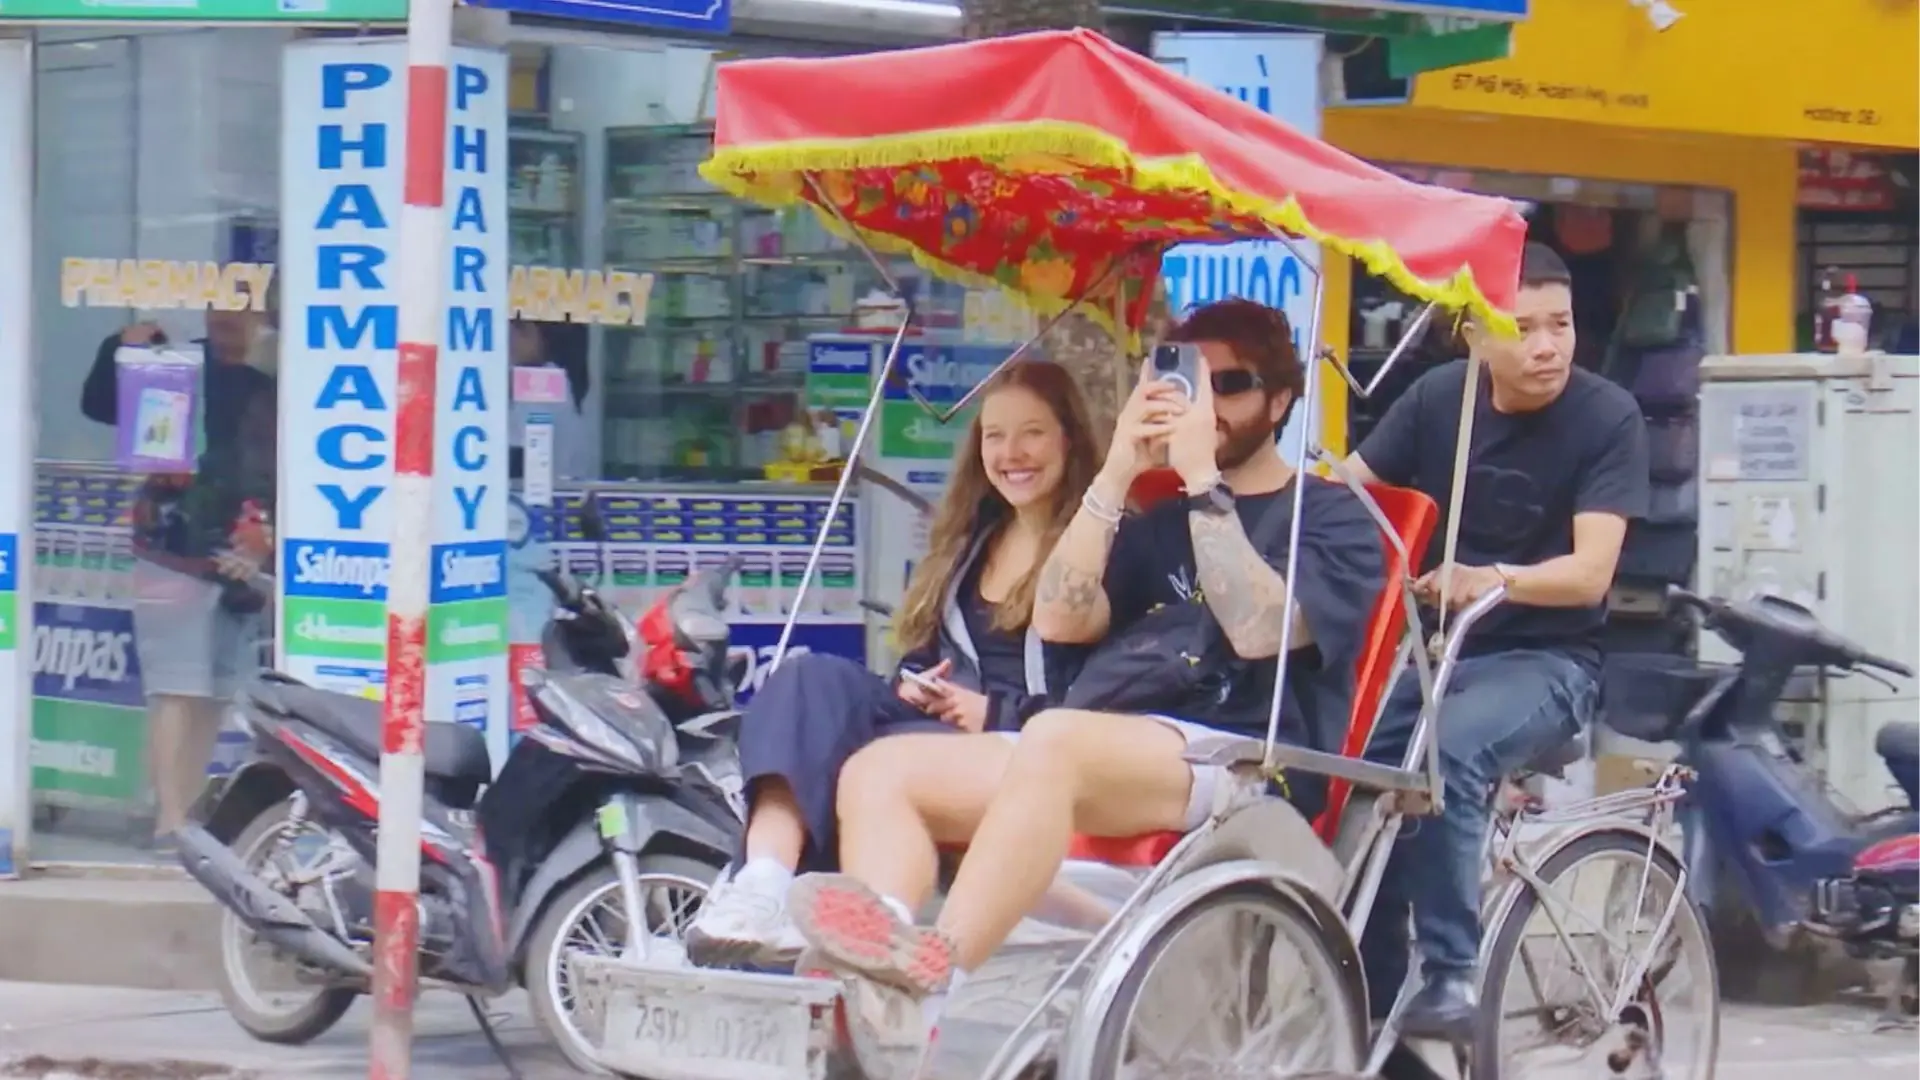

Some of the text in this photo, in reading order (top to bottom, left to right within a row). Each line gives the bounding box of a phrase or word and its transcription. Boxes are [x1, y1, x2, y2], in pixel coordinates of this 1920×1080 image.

[61, 257, 275, 312] PHARMACY
[306, 62, 399, 531] PHARMACY
[448, 64, 494, 531] PHARMACY
[508, 264, 654, 327] ARMACY
[294, 545, 390, 594] Salonpa
[31, 625, 133, 690] onpas
